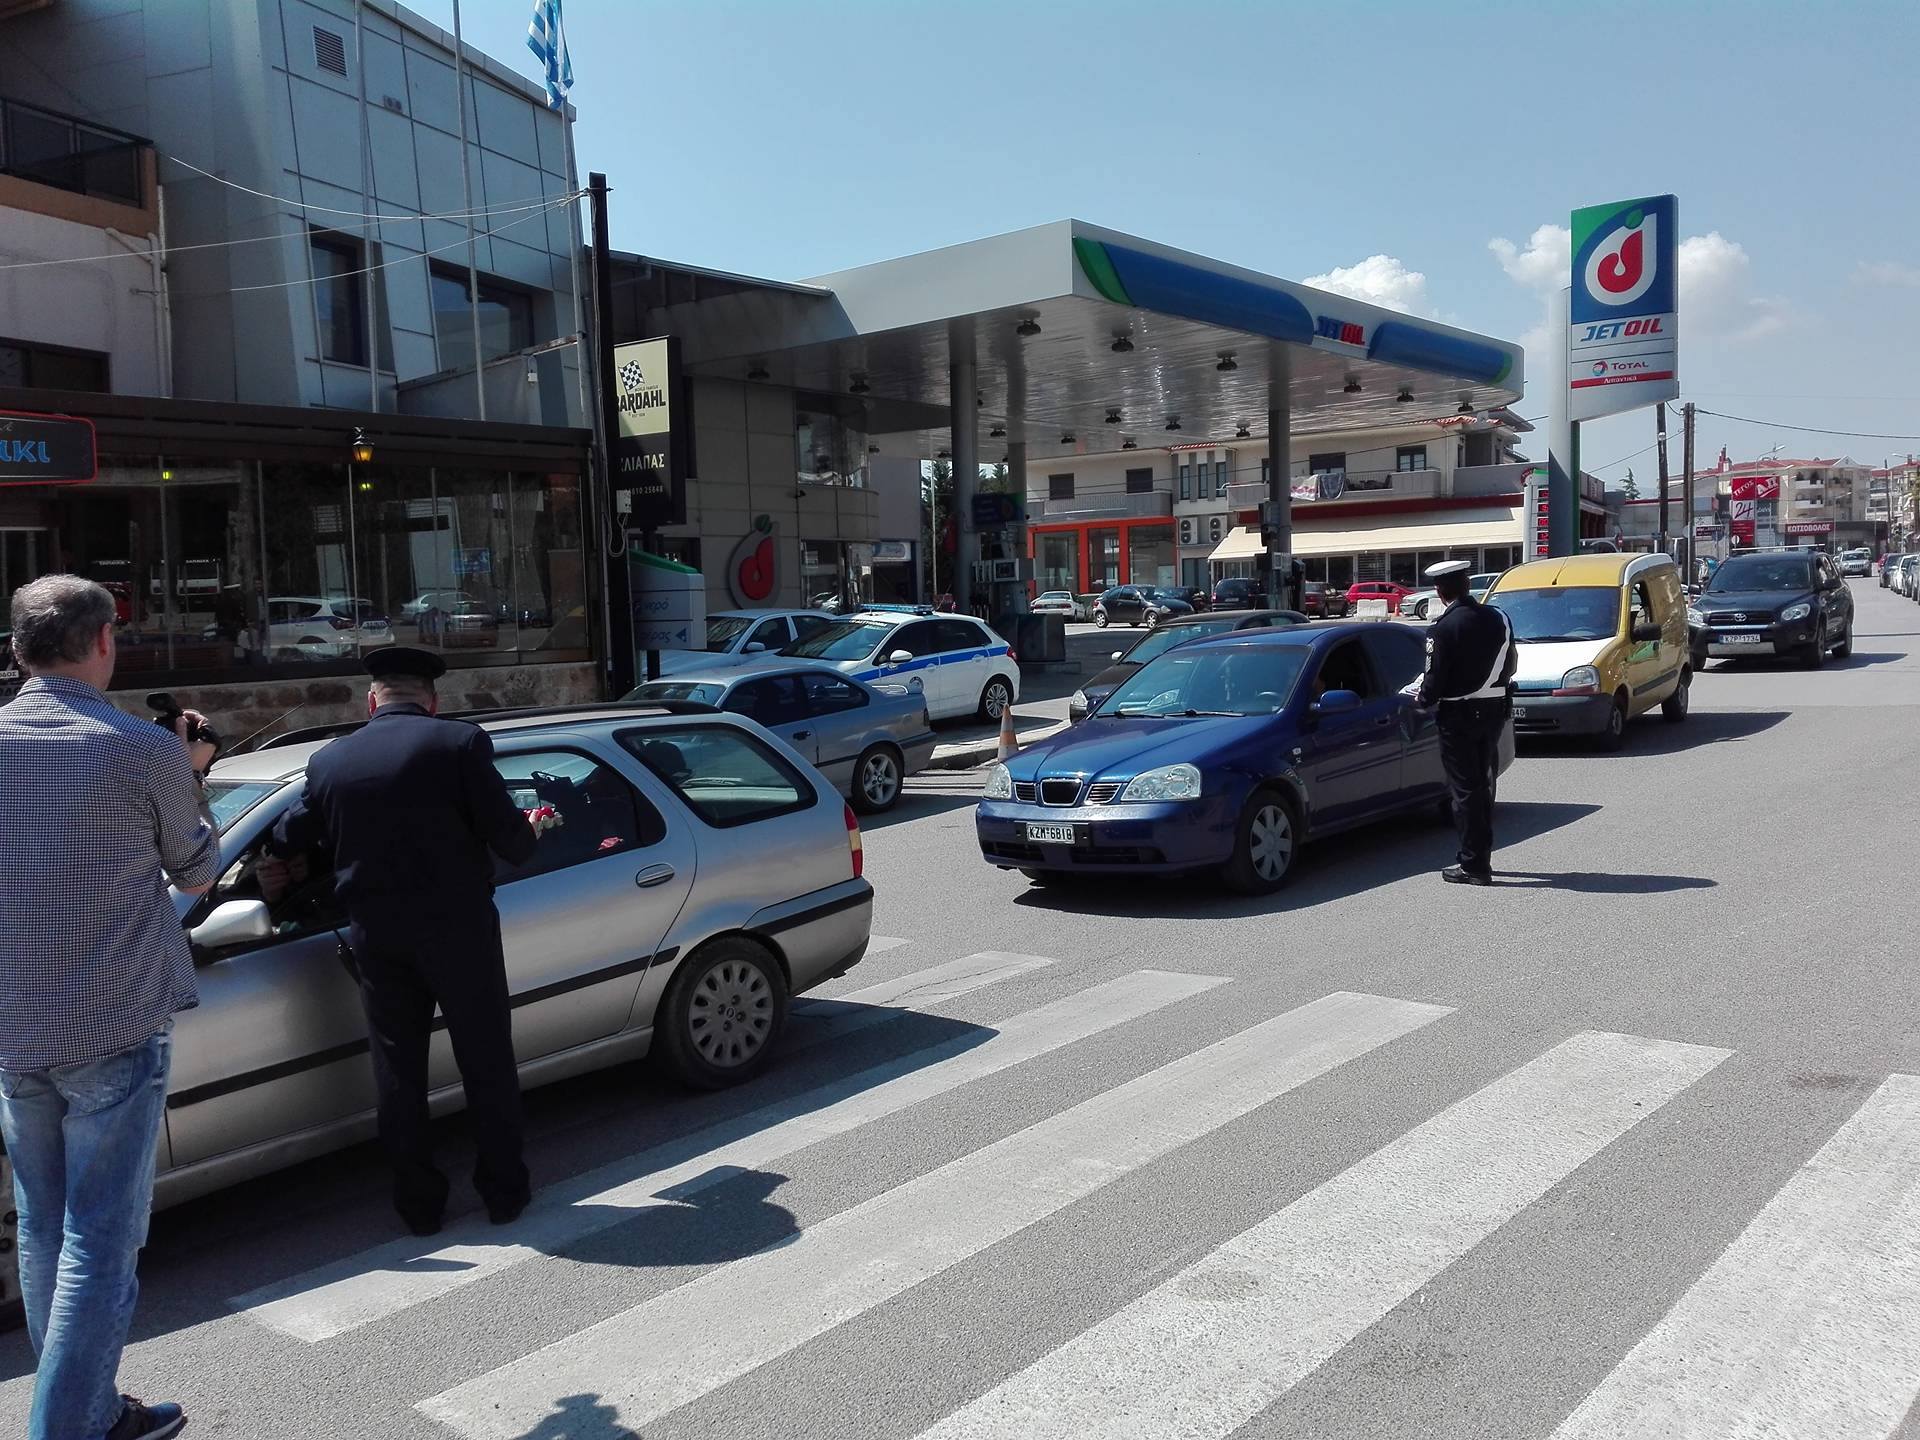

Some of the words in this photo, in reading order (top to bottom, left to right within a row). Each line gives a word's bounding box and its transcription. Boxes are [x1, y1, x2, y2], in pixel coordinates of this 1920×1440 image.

[1581, 318, 1663, 342] JETOIL
[1611, 361, 1649, 370] TOTAL
[617, 389, 667, 413] ARDAHL
[620, 453, 665, 472] ΛΙΑΠΑΣ
[1735, 502, 1753, 519] 24
